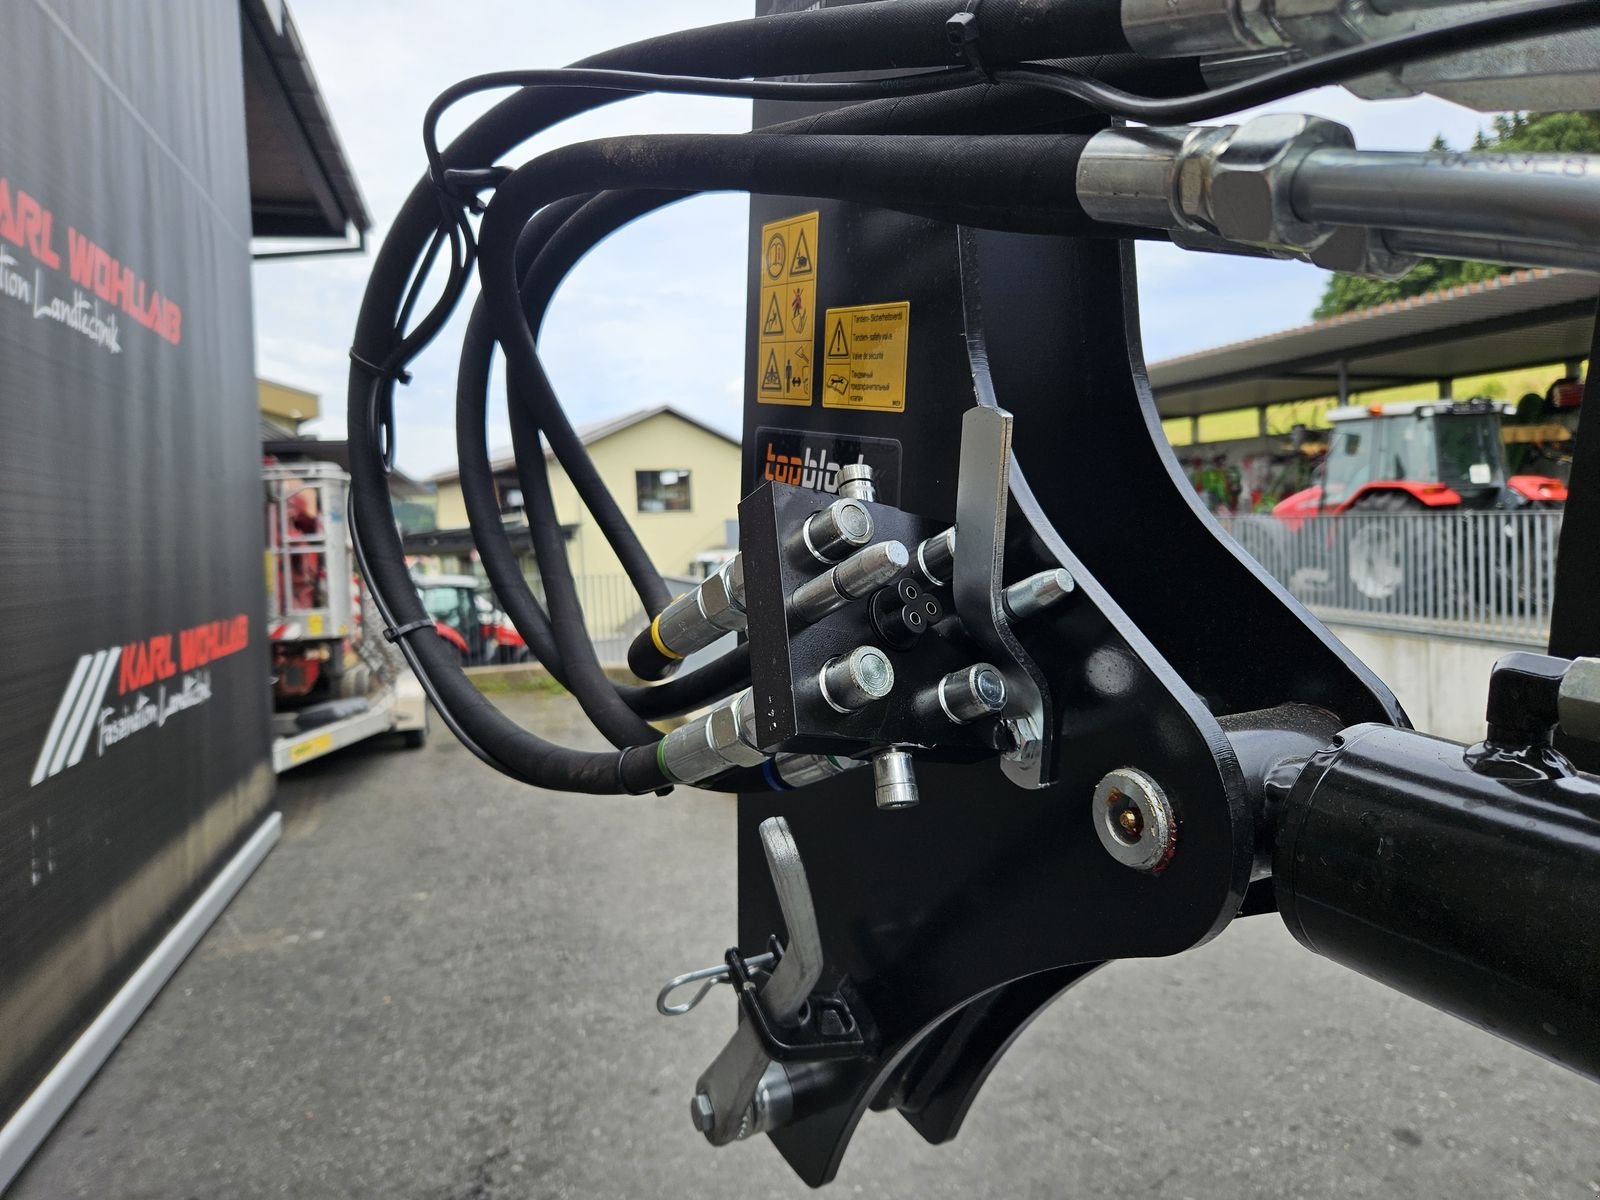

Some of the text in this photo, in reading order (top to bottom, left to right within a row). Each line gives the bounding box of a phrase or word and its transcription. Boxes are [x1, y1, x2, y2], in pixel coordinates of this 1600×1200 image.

[33, 267, 122, 354] Landtechnik
[765, 443, 864, 493] topblo
[118, 634, 176, 696] KARL
